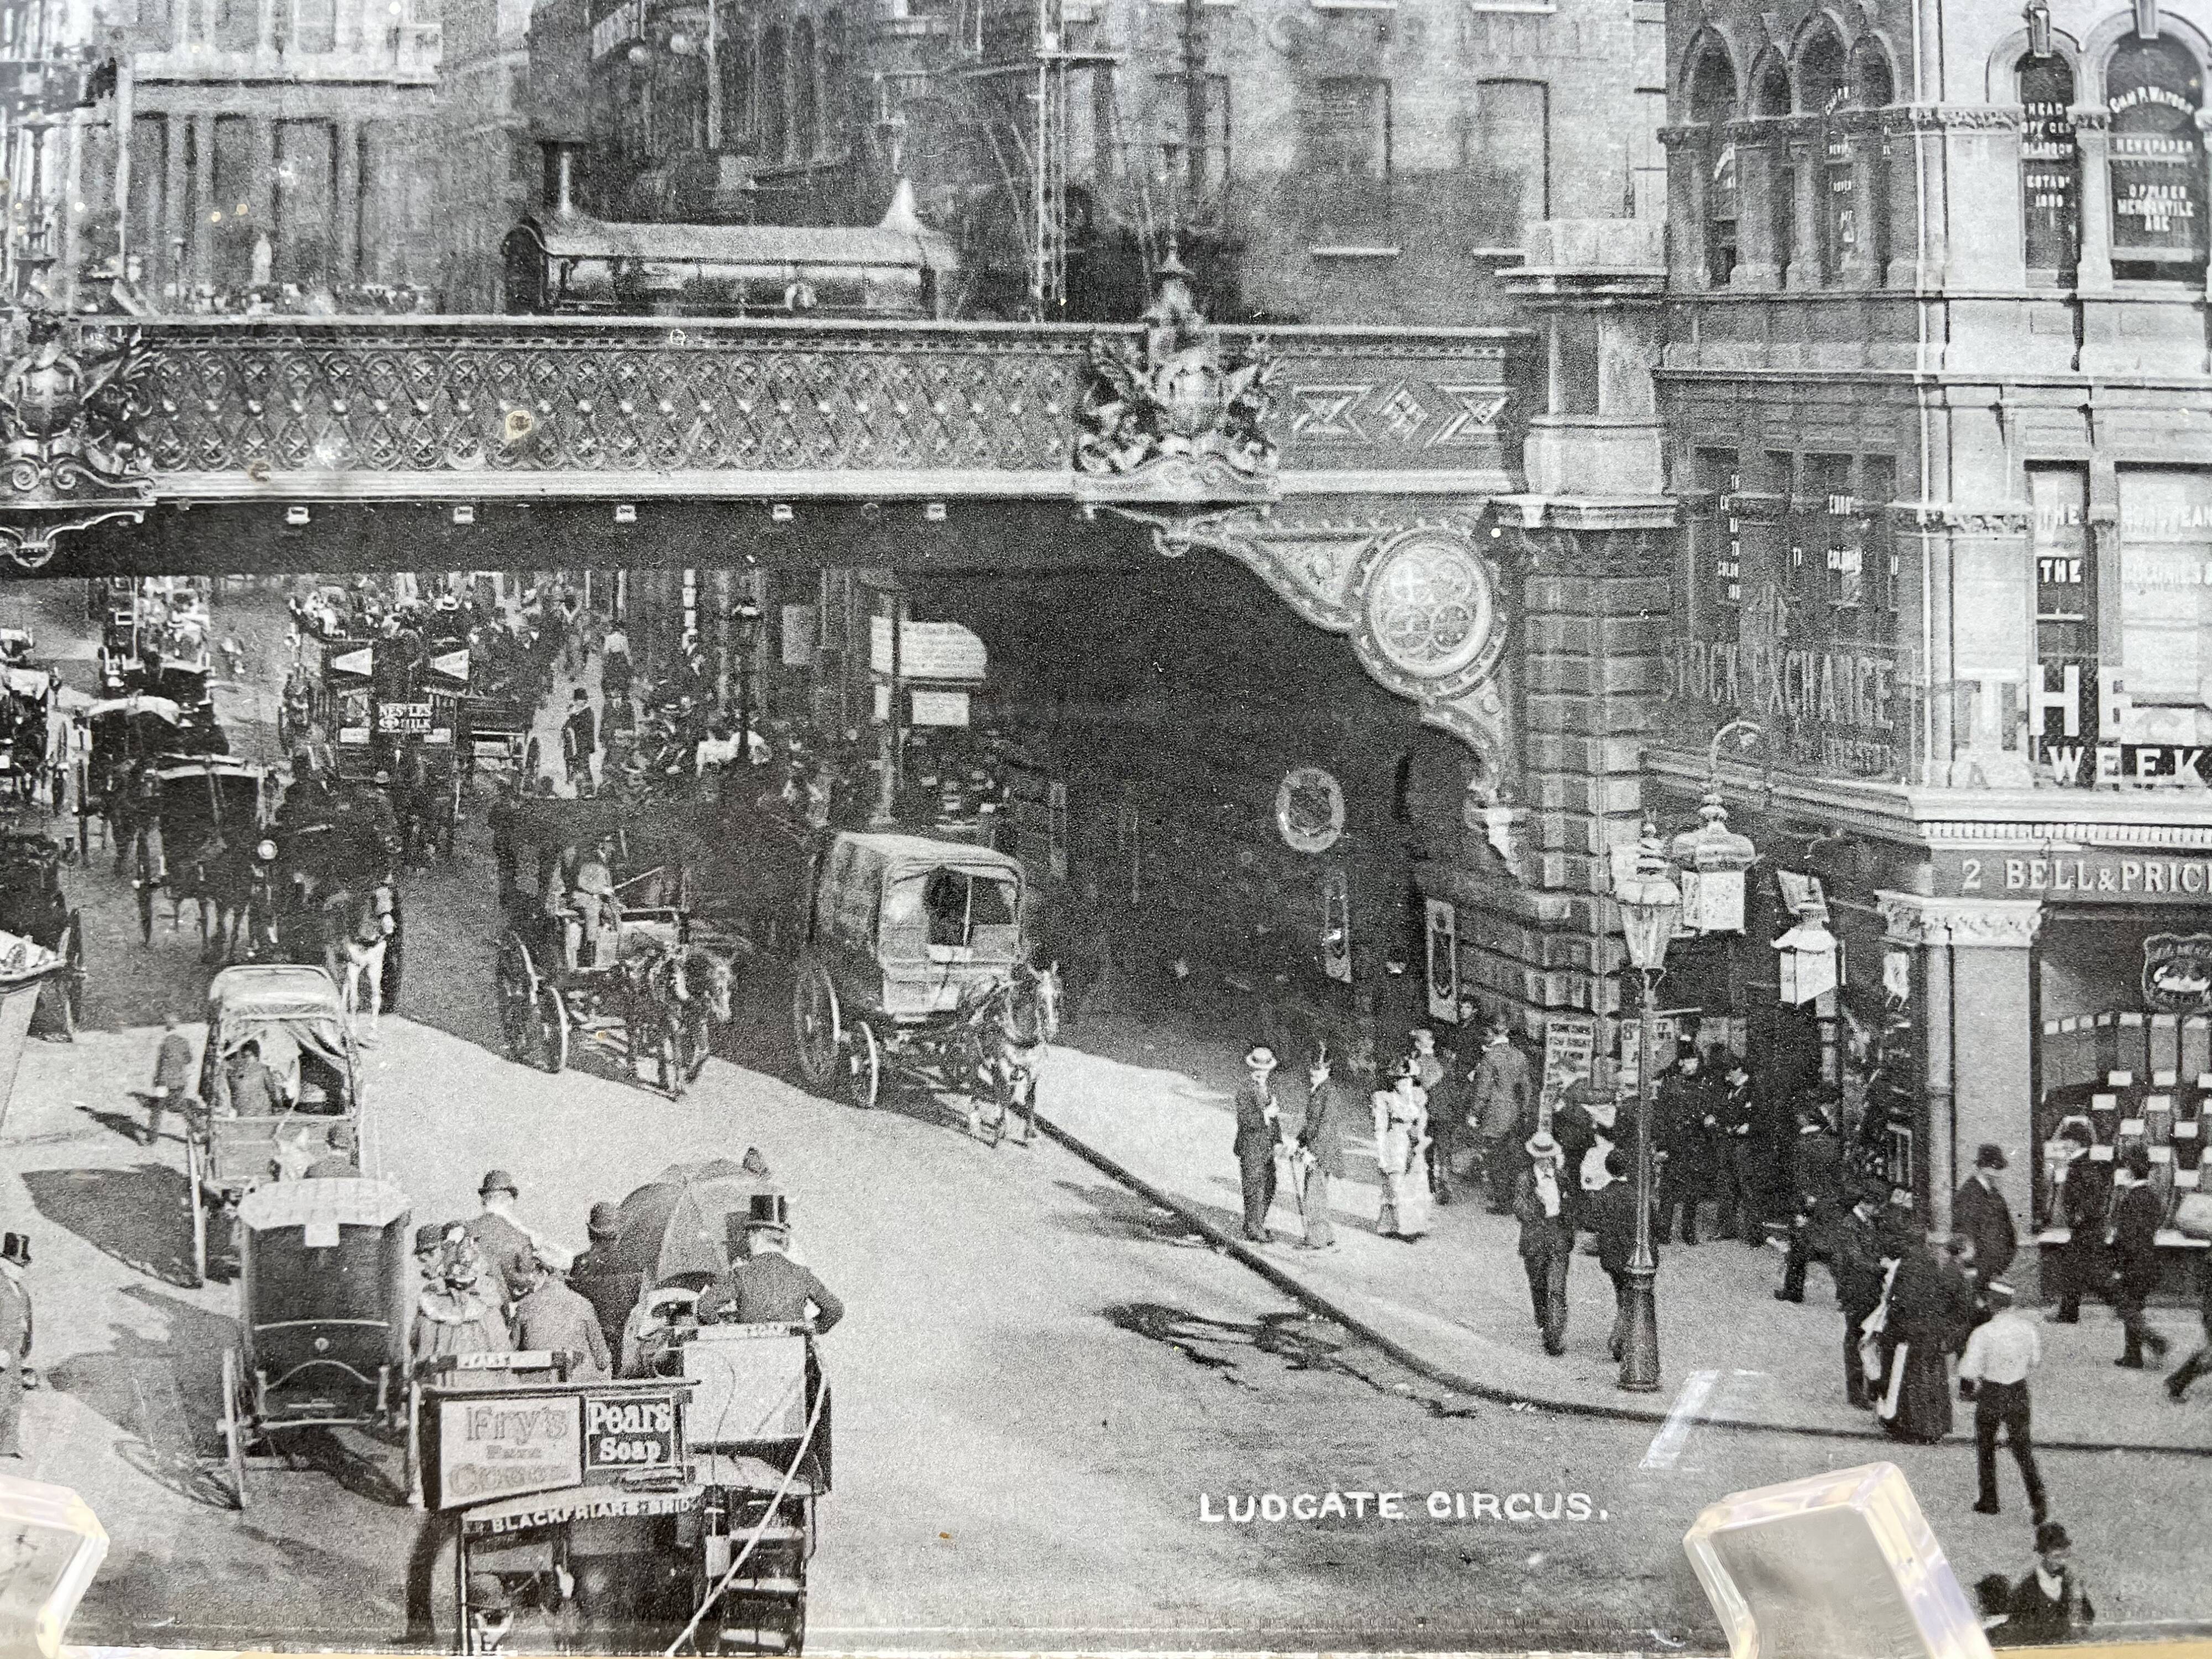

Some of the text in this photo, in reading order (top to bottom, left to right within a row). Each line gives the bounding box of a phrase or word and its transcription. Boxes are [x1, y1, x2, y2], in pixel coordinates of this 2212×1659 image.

[2028, 102, 2063, 116] HEAD
[2021, 121, 2071, 134] OFFCES
[2116, 139, 2193, 154] NEWSPAPER
[2039, 559, 2081, 583] THE
[1962, 858, 1981, 889] 2
[467, 1406, 567, 1445] Fry's
[599, 1437, 661, 1466] Soap
[492, 1501, 638, 1533] BLACKFRIARS
